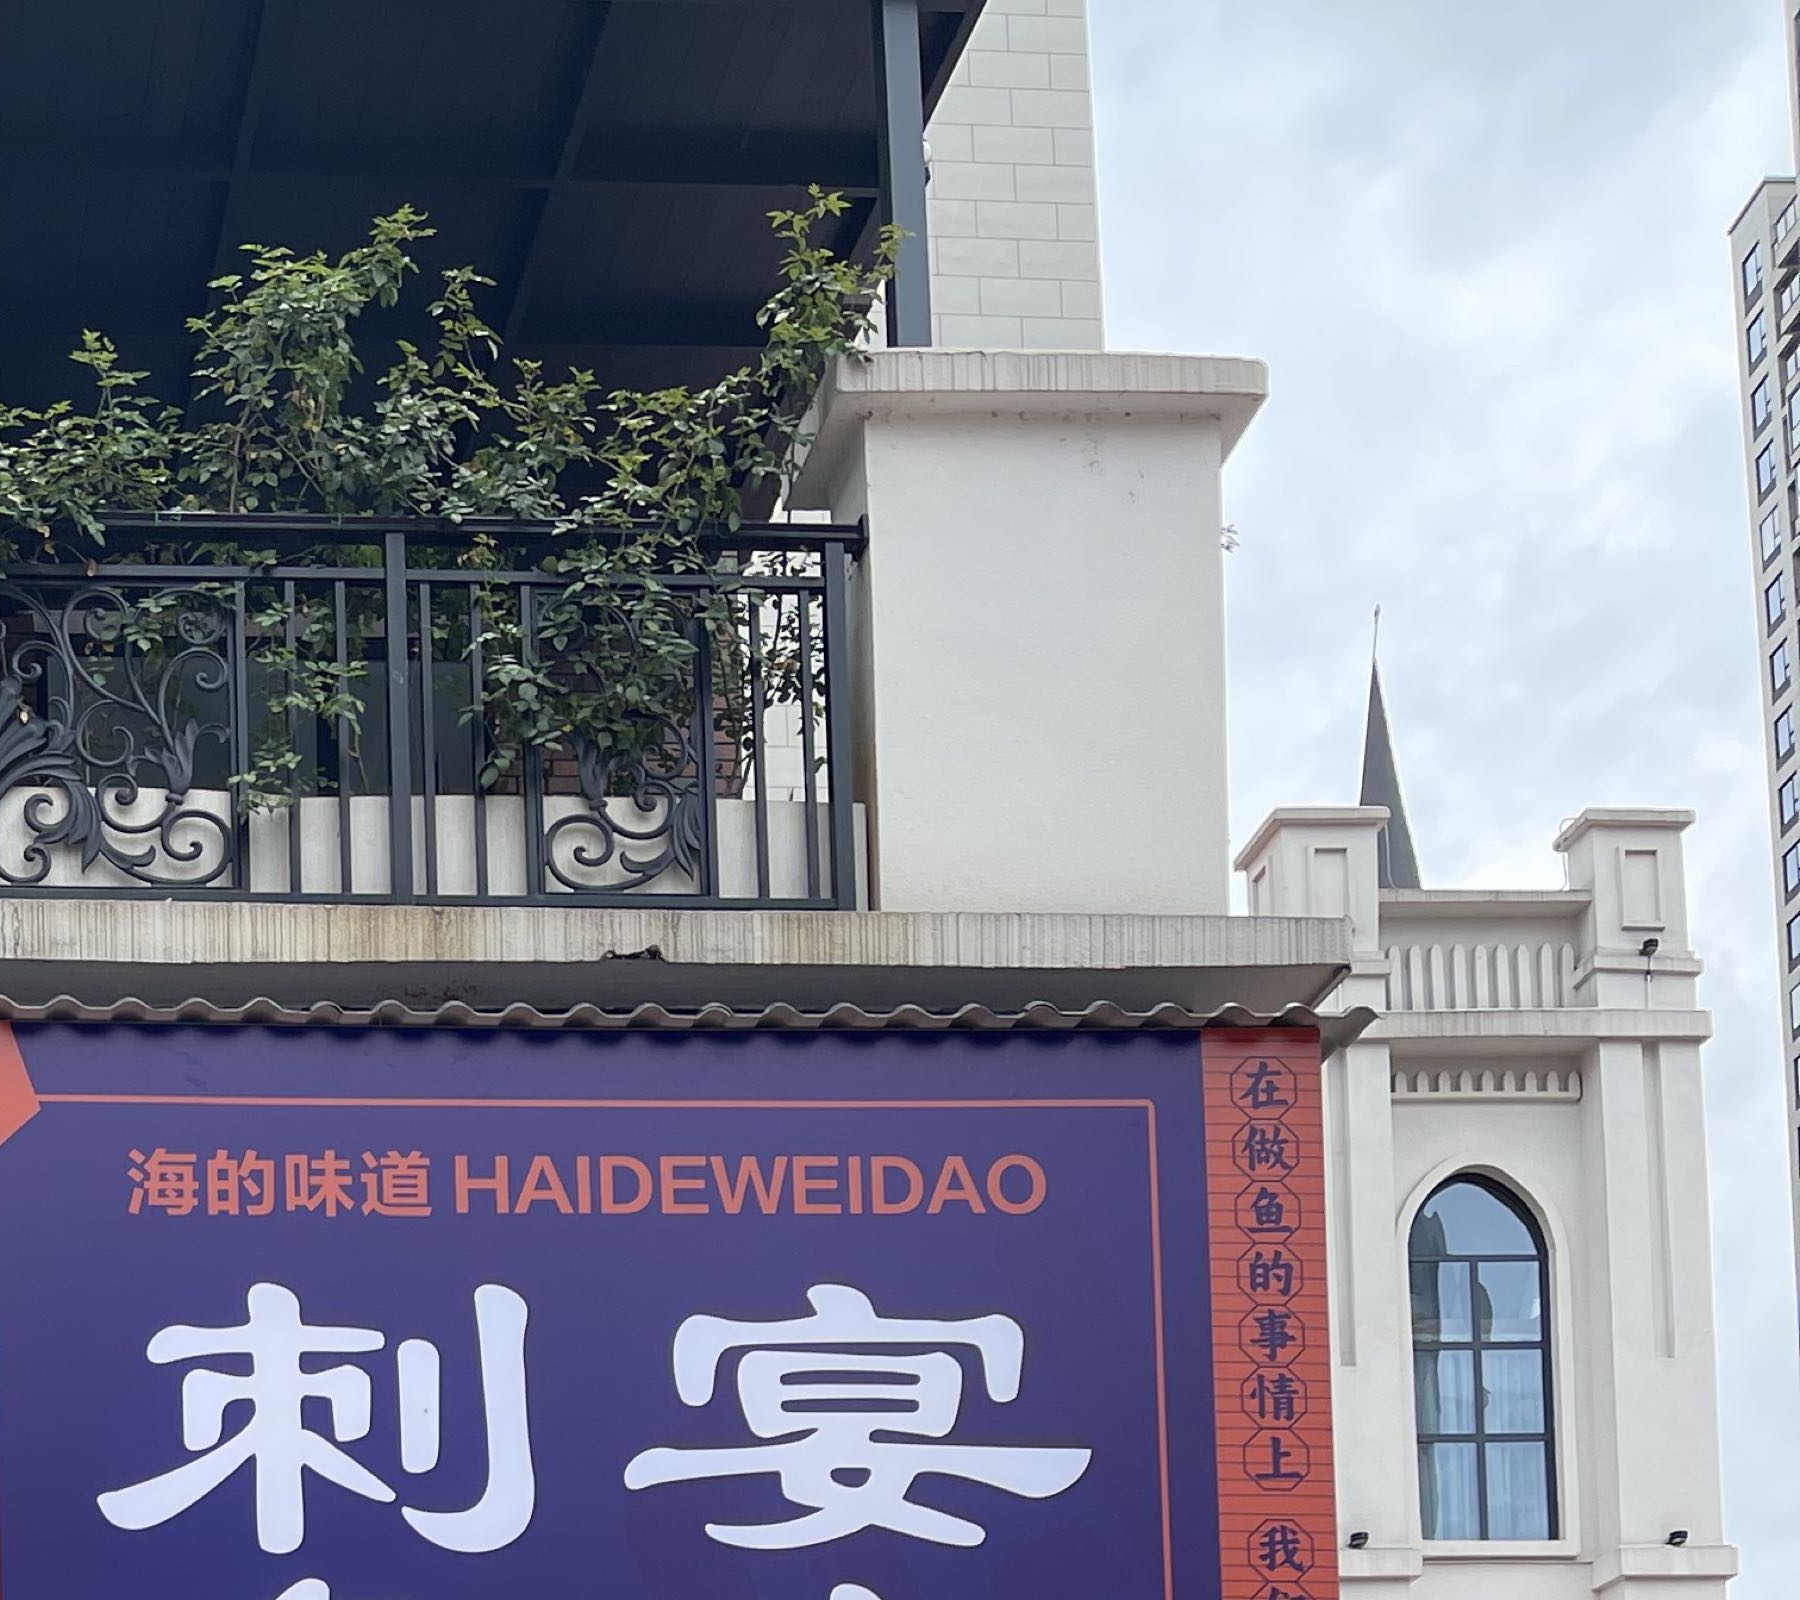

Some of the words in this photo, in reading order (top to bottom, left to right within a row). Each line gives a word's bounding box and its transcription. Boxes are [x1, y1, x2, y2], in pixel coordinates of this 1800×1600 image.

[126, 1148, 432, 1218] 海的味道
[455, 1153, 1048, 1215] HAIDEWEIDAO
[1239, 1061, 1305, 1481] 在做鱼的事情上
